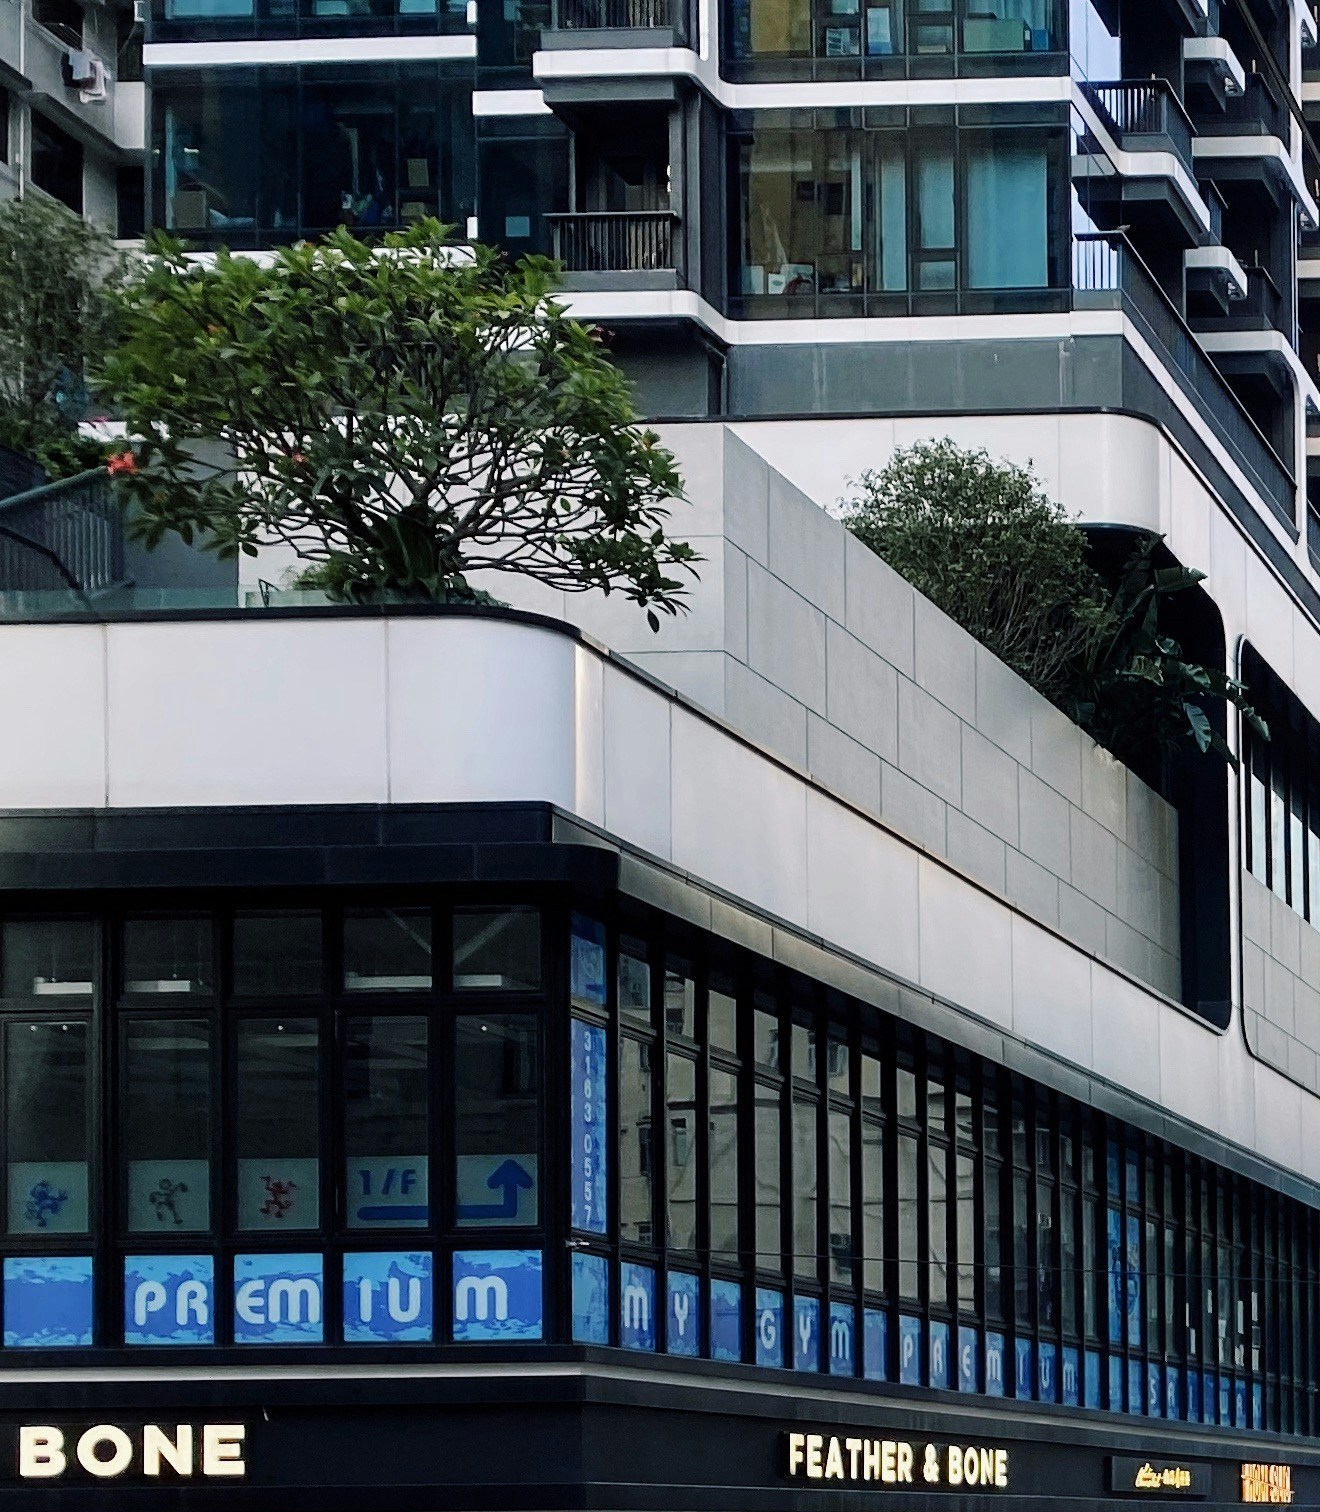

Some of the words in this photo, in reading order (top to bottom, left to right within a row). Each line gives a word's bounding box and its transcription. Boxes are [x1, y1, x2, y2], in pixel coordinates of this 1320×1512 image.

[358, 1168, 418, 1196] 1/F
[134, 1276, 508, 1326] PREMIUM
[760, 1309, 850, 1361] GYM
[19, 1424, 246, 1477] BONE
[789, 1432, 914, 1483] FEATHER
[923, 1443, 939, 1483] &
[948, 1445, 1008, 1487] BONE
